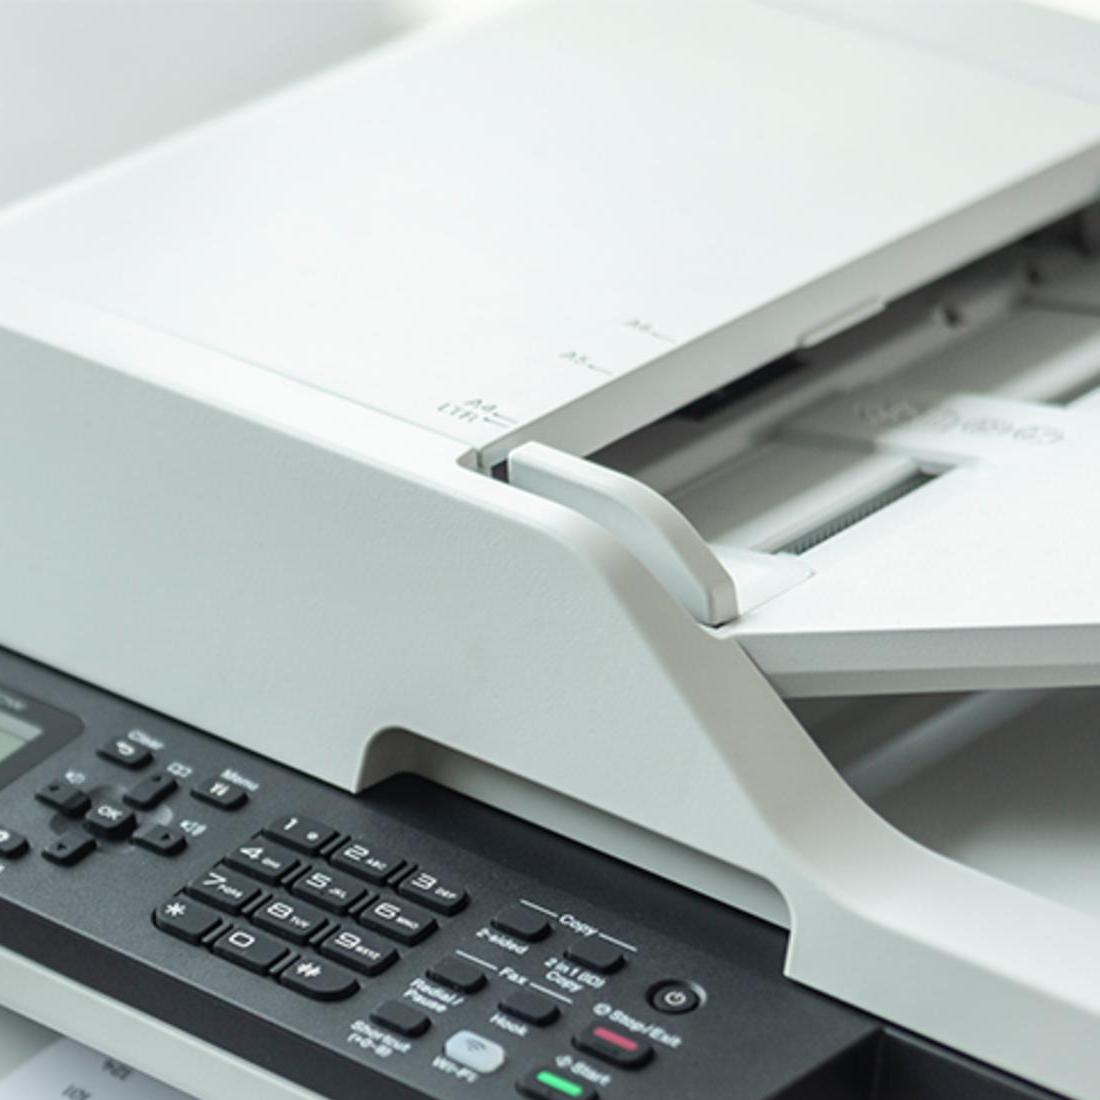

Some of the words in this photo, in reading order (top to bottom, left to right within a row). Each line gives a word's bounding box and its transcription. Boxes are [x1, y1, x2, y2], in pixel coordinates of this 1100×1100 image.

[127, 730, 165, 751] Clear
[221, 769, 259, 792] Menu
[97, 806, 123, 821] OK
[284, 818, 298, 831] 1
[240, 847, 264, 860] 4
[343, 844, 370, 862] 2
[202, 872, 227, 887] 7
[305, 872, 332, 889] 5
[410, 872, 437, 890] 3
[266, 902, 294, 919] 8
[374, 902, 399, 919] 6
[559, 913, 599, 937] Copy
[334, 932, 362, 950] 9
[476, 928, 530, 956] 2-sided
[544, 957, 558, 969] 2
[556, 963, 570, 974] in
[499, 966, 528, 986] Fax
[545, 971, 584, 993] Copy
[403, 988, 448, 1013] Pause
[489, 1013, 529, 1037] Hook
[609, 1009, 683, 1048] Stop/Exit
[351, 1020, 411, 1053] Shortcut
[570, 1062, 612, 1087] Start
